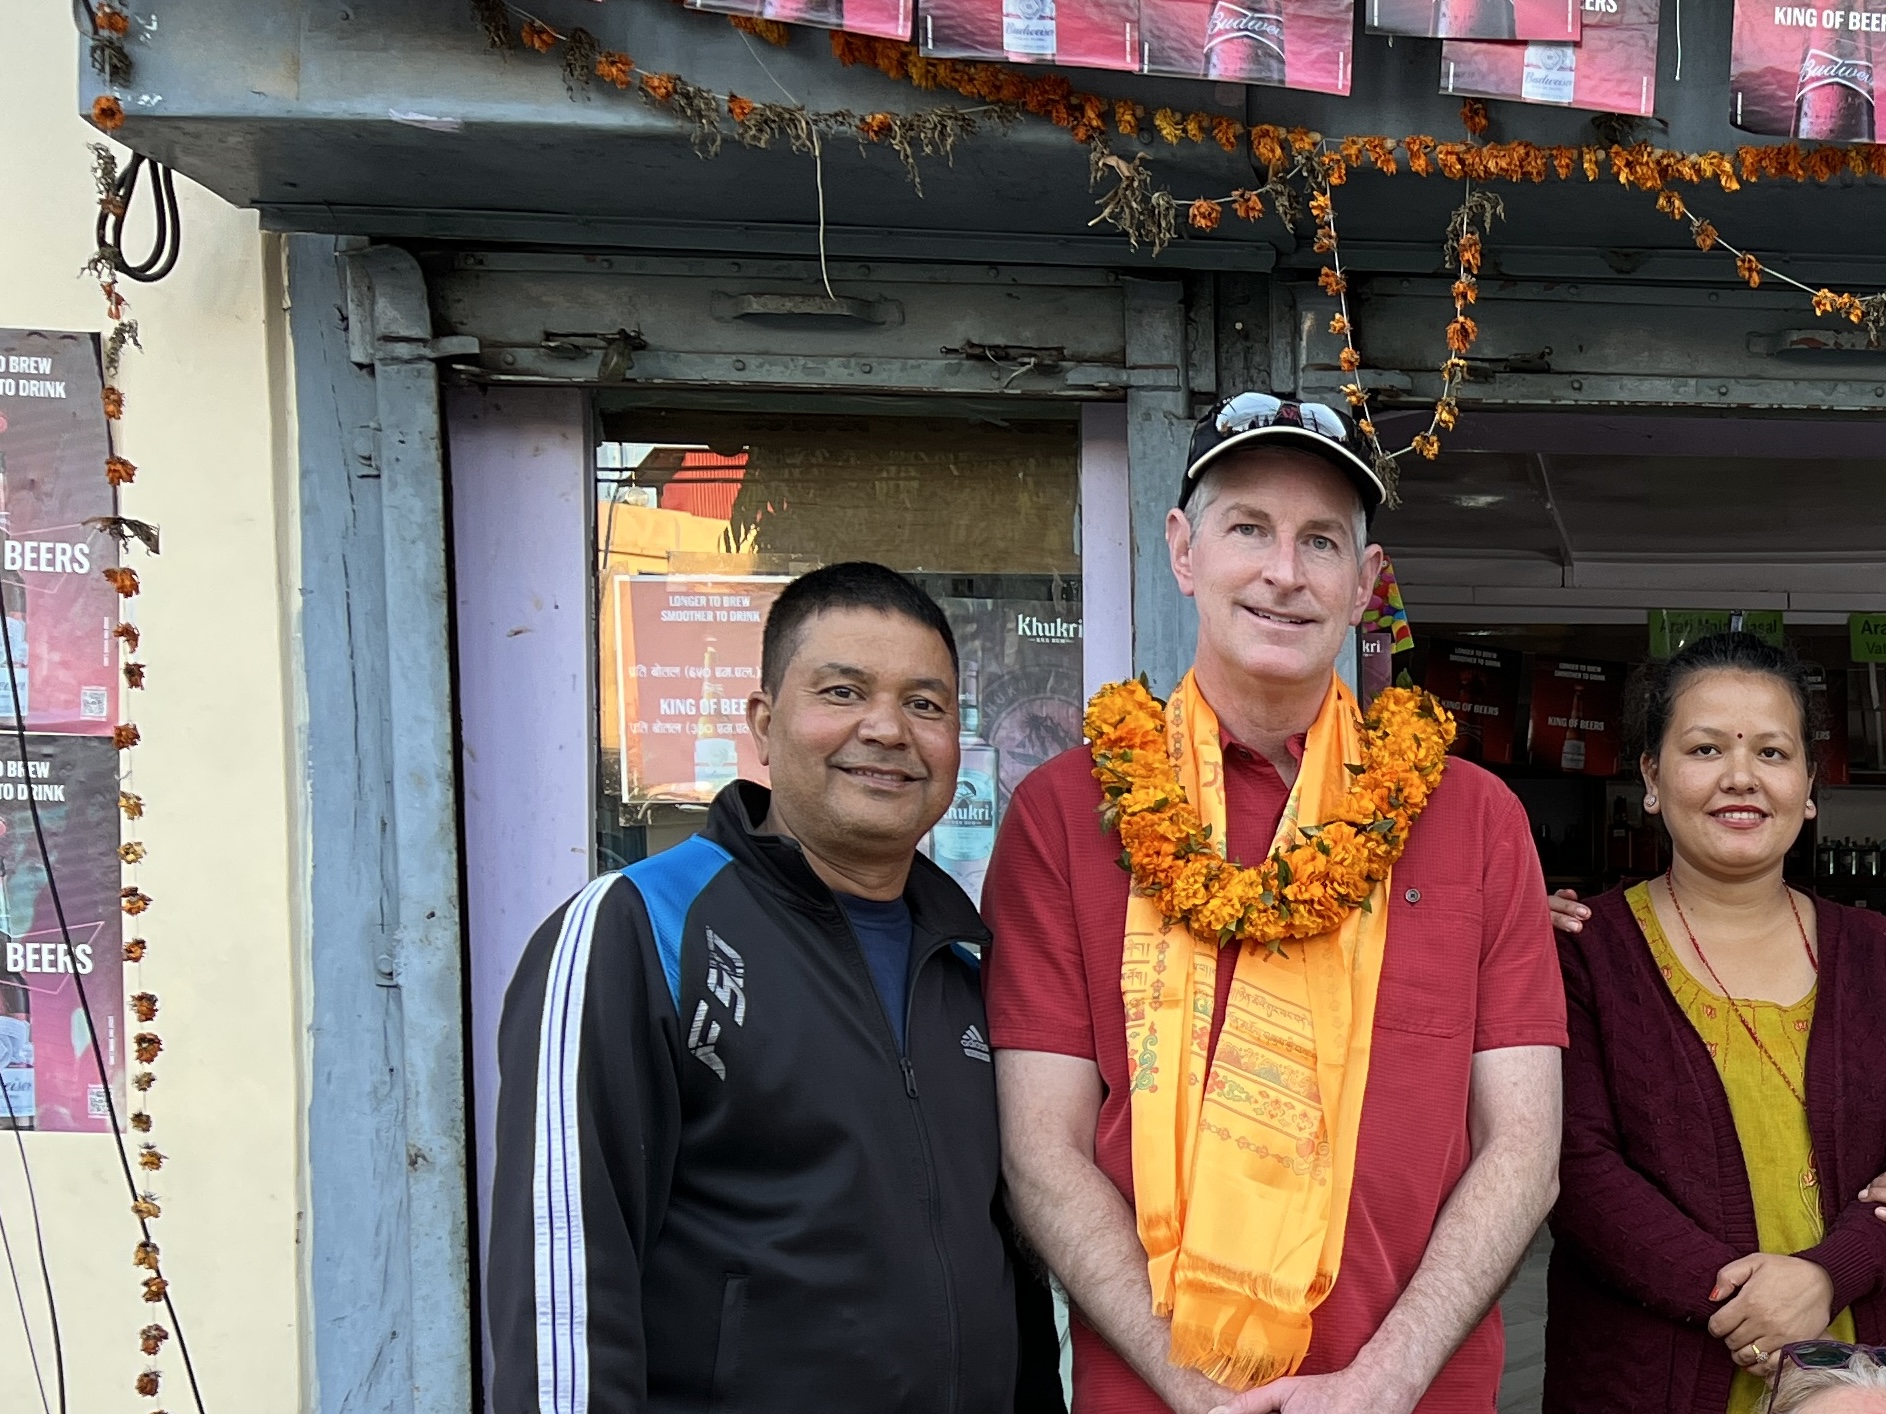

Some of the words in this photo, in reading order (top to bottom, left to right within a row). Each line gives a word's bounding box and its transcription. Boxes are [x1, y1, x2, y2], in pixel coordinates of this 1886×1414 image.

[1774, 6, 1818, 28] KING
[1821, 9, 1846, 29] OF
[9, 355, 53, 375] BREW
[19, 379, 67, 399] DRINK
[4, 539, 91, 574] BEERS
[669, 595, 707, 608] LONGER
[709, 596, 720, 607] TO
[722, 595, 751, 607] BREW
[660, 610, 714, 623] SMOOTHER
[716, 611, 728, 622] TO
[729, 610, 761, 623] DRINK
[1017, 613, 1083, 639] Khukri
[660, 698, 696, 716] KING
[699, 699, 718, 715] OF
[1473, 704, 1499, 716] BEERS
[1547, 715, 1568, 728] KING
[1568, 718, 1579, 729] OF
[1579, 720, 1605, 732] BEERS
